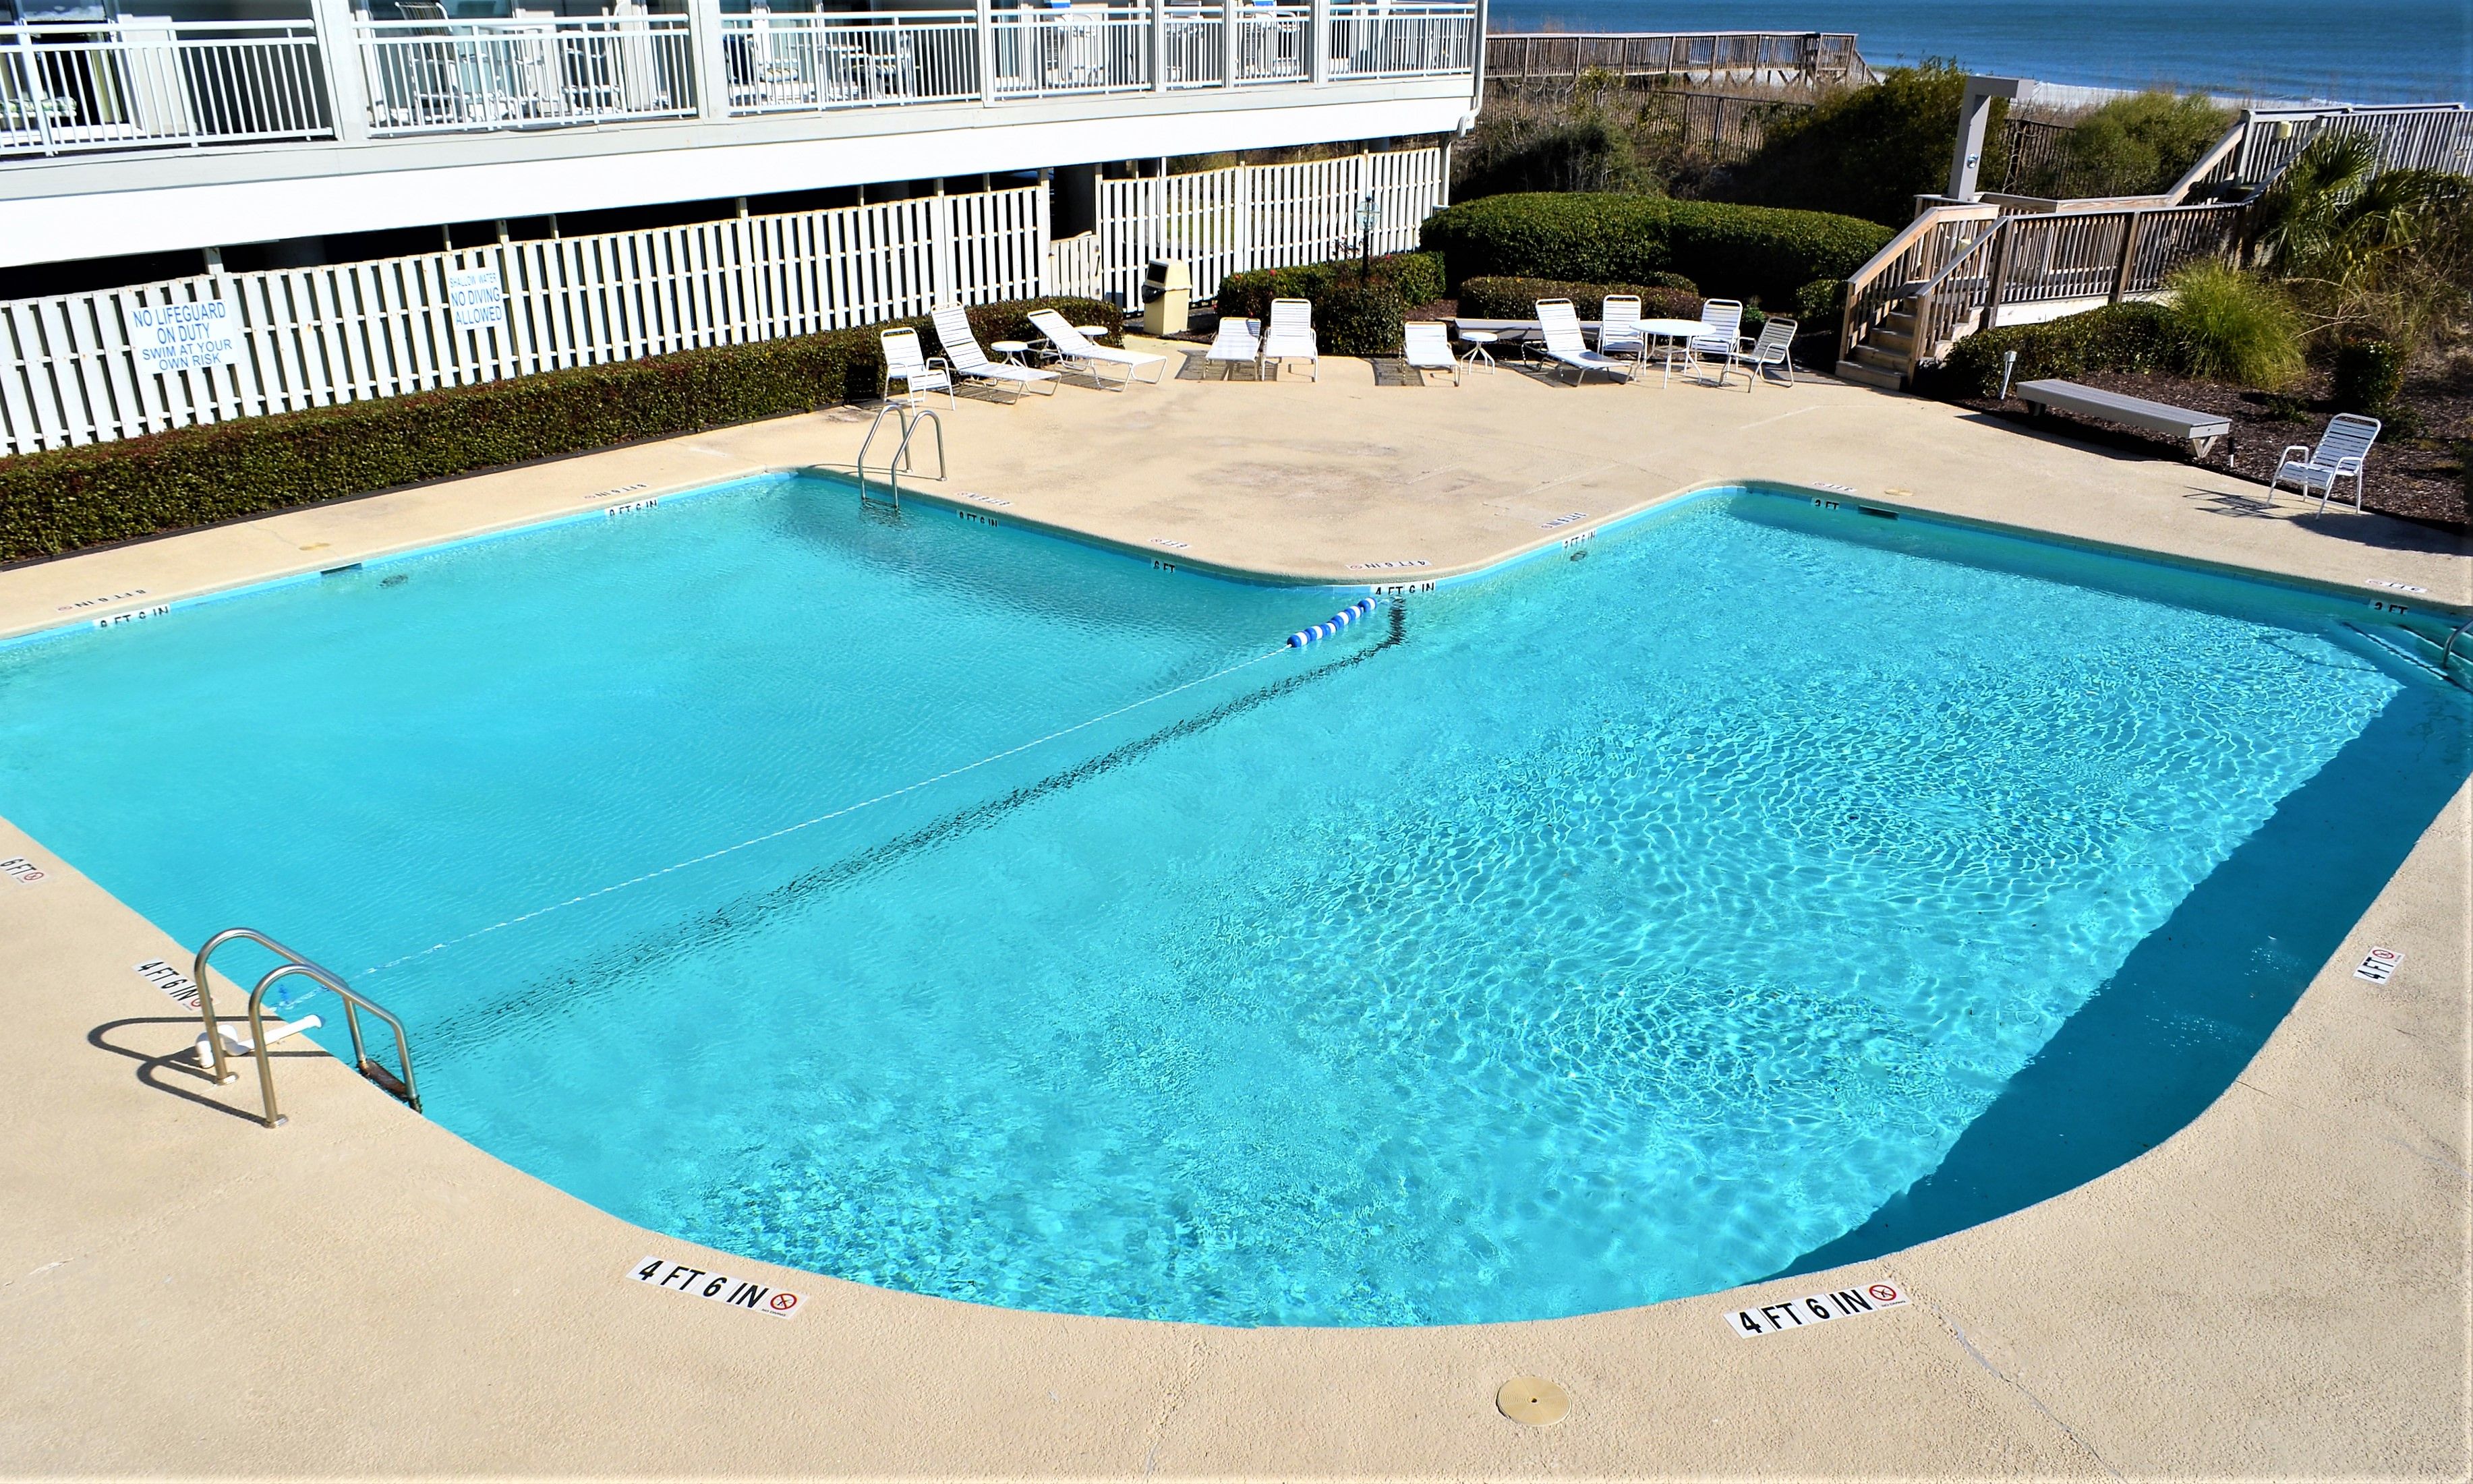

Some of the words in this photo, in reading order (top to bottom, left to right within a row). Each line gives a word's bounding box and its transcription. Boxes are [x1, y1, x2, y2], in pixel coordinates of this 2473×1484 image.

[451, 291, 466, 307] NO
[468, 287, 500, 305] DIVING
[134, 309, 152, 328] NO
[155, 301, 227, 325] LIFEGUARD
[455, 305, 502, 326] ALLOWED
[157, 327, 176, 345] ON
[177, 322, 210, 343] DUTY
[142, 346, 177, 361] SWIM
[180, 343, 194, 356] AT
[196, 338, 233, 353] YOUR
[159, 357, 190, 371] OWN
[192, 352, 221, 366] RISK
[1375, 587, 1381, 595] 4
[1388, 586, 1403, 595] FT
[1422, 582, 1434, 593] IN
[153, 606, 169, 617] IN
[2388, 603, 2408, 614] FT
[0, 858, 24, 866] 6
[5, 863, 37, 875] FT
[138, 961, 164, 972] 4
[2362, 957, 2394, 973] FT
[144, 967, 180, 982] FT
[2357, 970, 2386, 980] 4
[161, 979, 187, 989] 6
[169, 984, 199, 1001] IN
[638, 1260, 664, 1281] 4
[660, 1266, 706, 1290] FT
[703, 1277, 728, 1297] 6
[726, 1282, 769, 1308] IN
[1739, 1311, 1763, 1334] 4
[1761, 1302, 1802, 1329] FT
[1805, 1298, 1831, 1319] 6
[1829, 1289, 1873, 1315] IN
